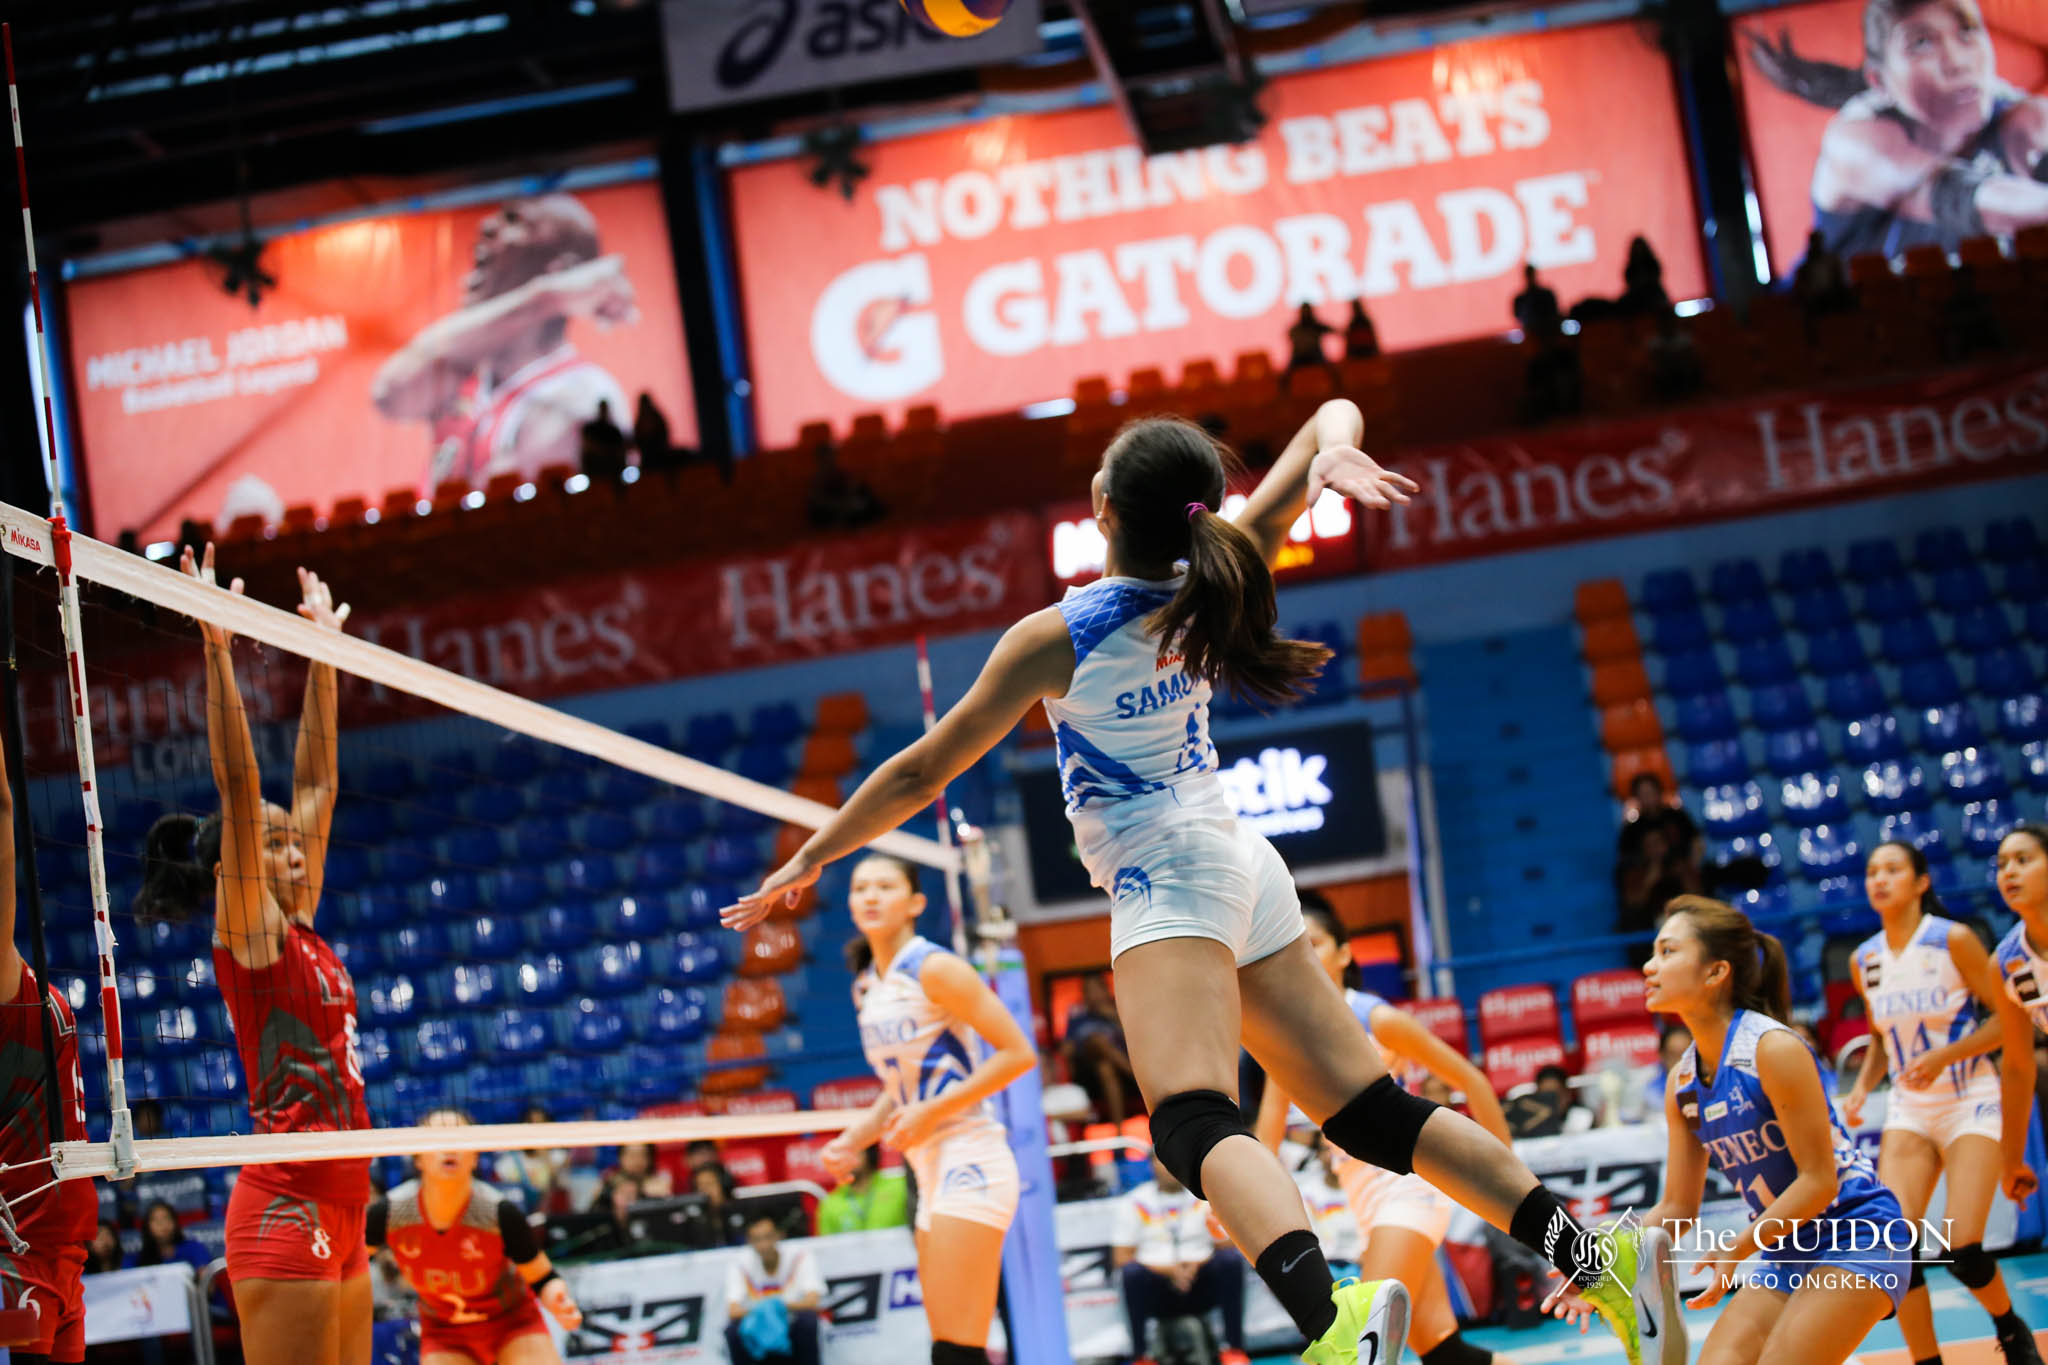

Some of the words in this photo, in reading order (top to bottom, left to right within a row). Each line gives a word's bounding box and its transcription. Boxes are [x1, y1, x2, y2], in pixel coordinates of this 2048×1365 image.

[876, 142, 1268, 252] NOTHING
[1277, 80, 1551, 183] BEATS
[963, 170, 1598, 356] GATORADE
[86, 335, 221, 391] MICHAEL
[226, 313, 348, 369] JORDAN
[1755, 390, 2048, 492] Hanes
[1386, 446, 1676, 548] Hanes
[718, 542, 1008, 650] Hanes
[311, 1226, 332, 1260] 8
[439, 1293, 489, 1324] 2
